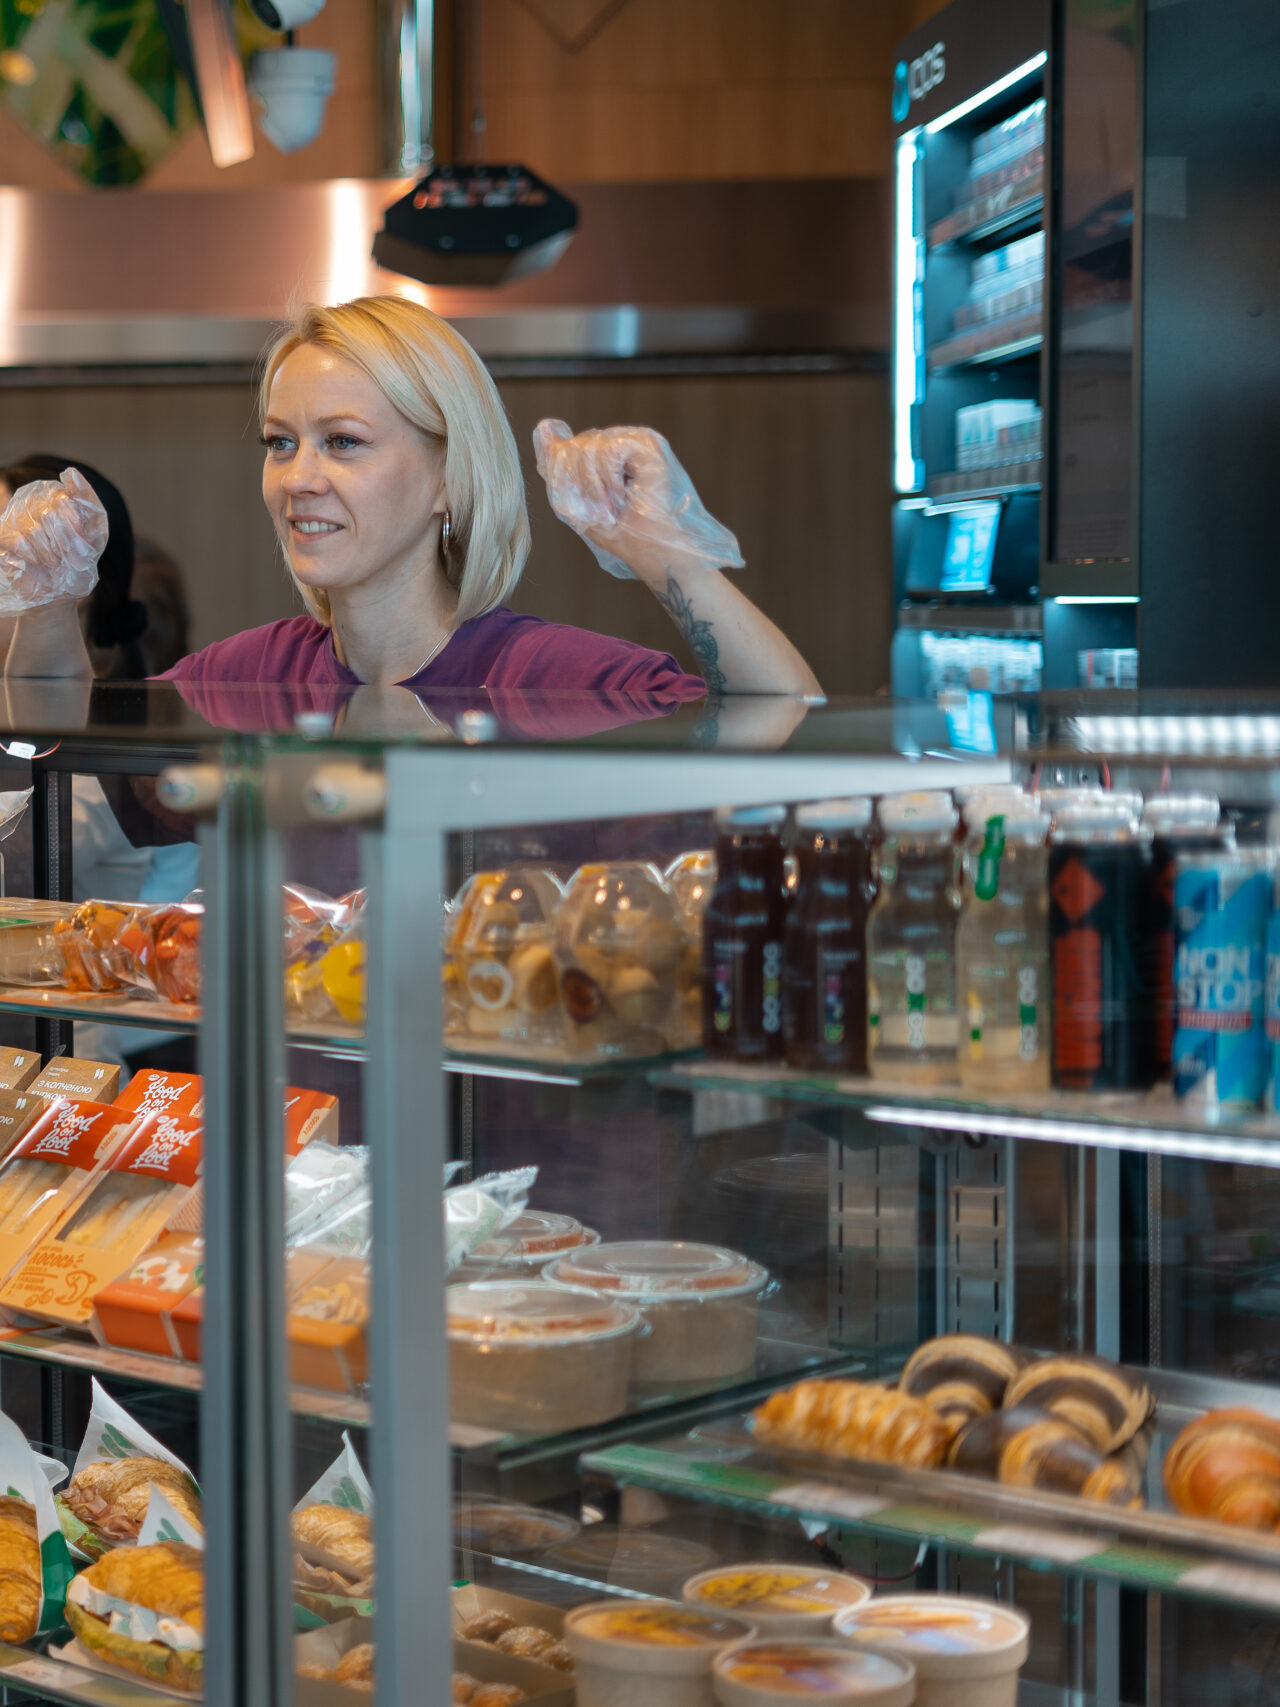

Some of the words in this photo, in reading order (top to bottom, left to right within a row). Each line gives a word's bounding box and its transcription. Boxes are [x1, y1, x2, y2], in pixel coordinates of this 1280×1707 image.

[45, 1080, 93, 1095] копченою
[143, 1076, 192, 1101] food
[152, 1099, 165, 1108] on
[53, 1103, 104, 1131] food
[30, 1127, 81, 1154] foot
[60, 1128, 74, 1136] on
[151, 1117, 205, 1146] food
[128, 1144, 182, 1170] foot
[159, 1143, 174, 1152] on
